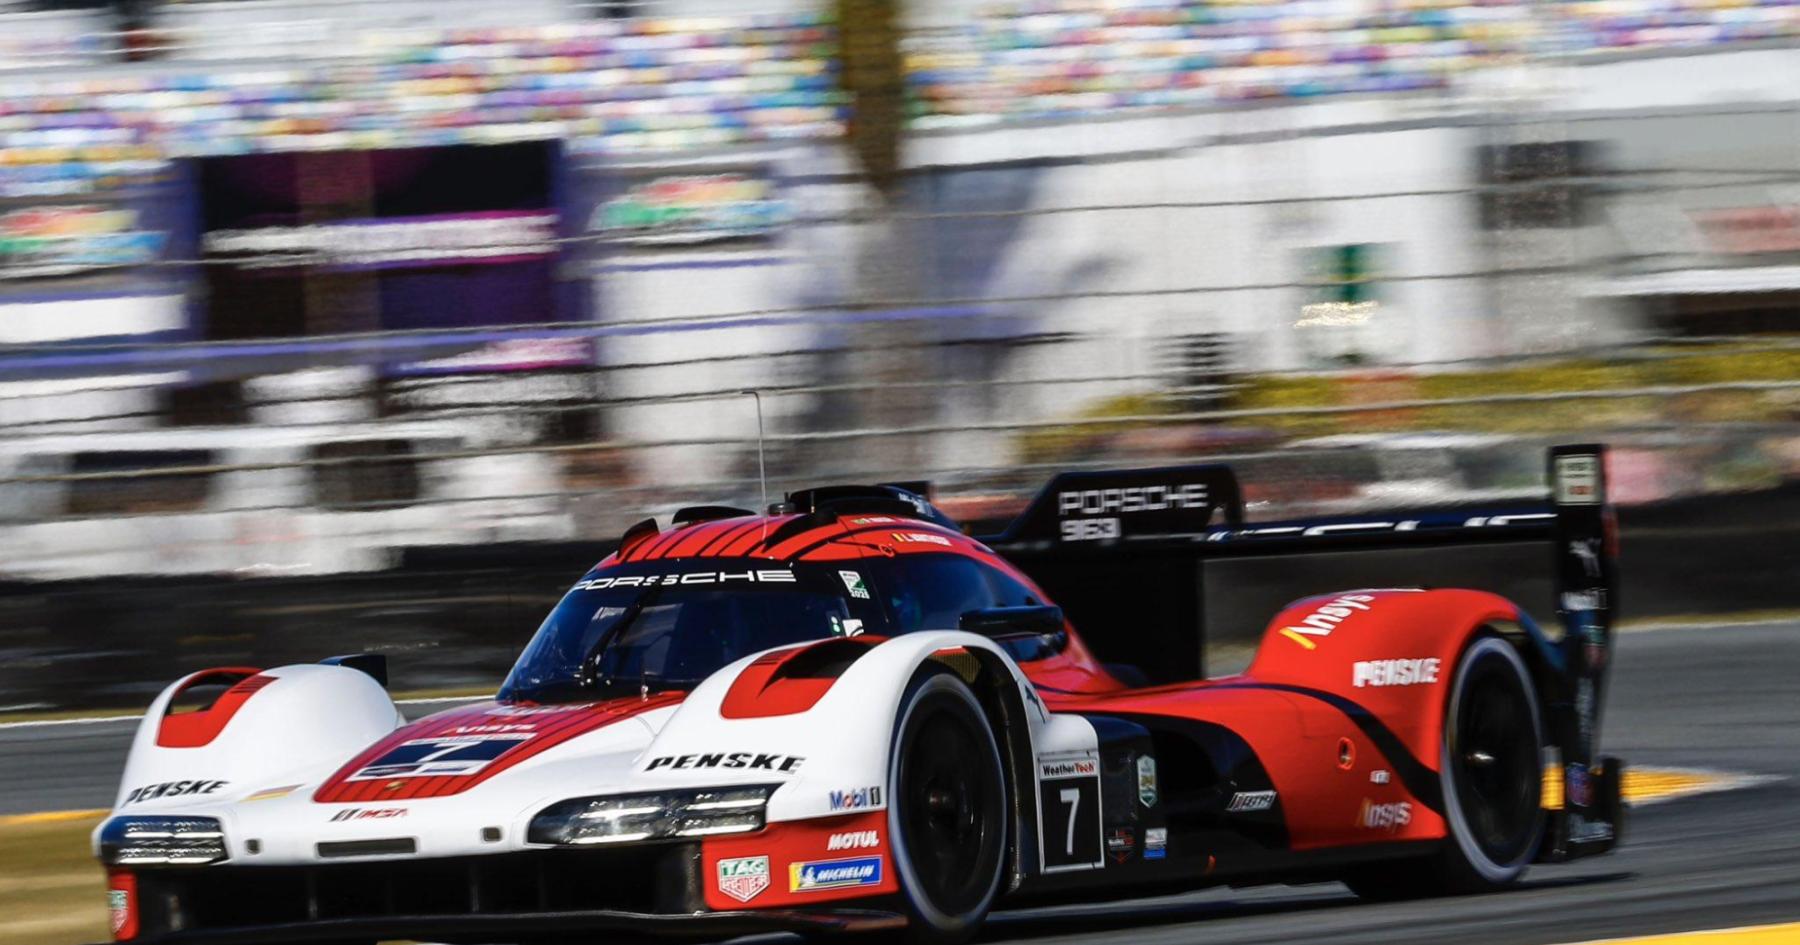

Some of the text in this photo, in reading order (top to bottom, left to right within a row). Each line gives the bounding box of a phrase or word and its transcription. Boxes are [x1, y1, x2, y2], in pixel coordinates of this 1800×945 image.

[1058, 484, 1208, 515] PORSCHE
[1060, 517, 1121, 541] 963
[571, 570, 797, 591] PORSCHE
[1279, 594, 1376, 651] Ansys
[1352, 657, 1441, 687] PENSKE
[645, 752, 806, 775] PENSKE
[1043, 762, 1095, 776] WeatherTech
[120, 780, 230, 809] PENSKE
[829, 790, 868, 810] Mobil
[354, 808, 409, 819] IMSA
[1060, 788, 1080, 855] 7
[827, 830, 879, 850] MOTUL
[721, 858, 767, 876] TAG
[816, 865, 875, 882] MICHELIN
